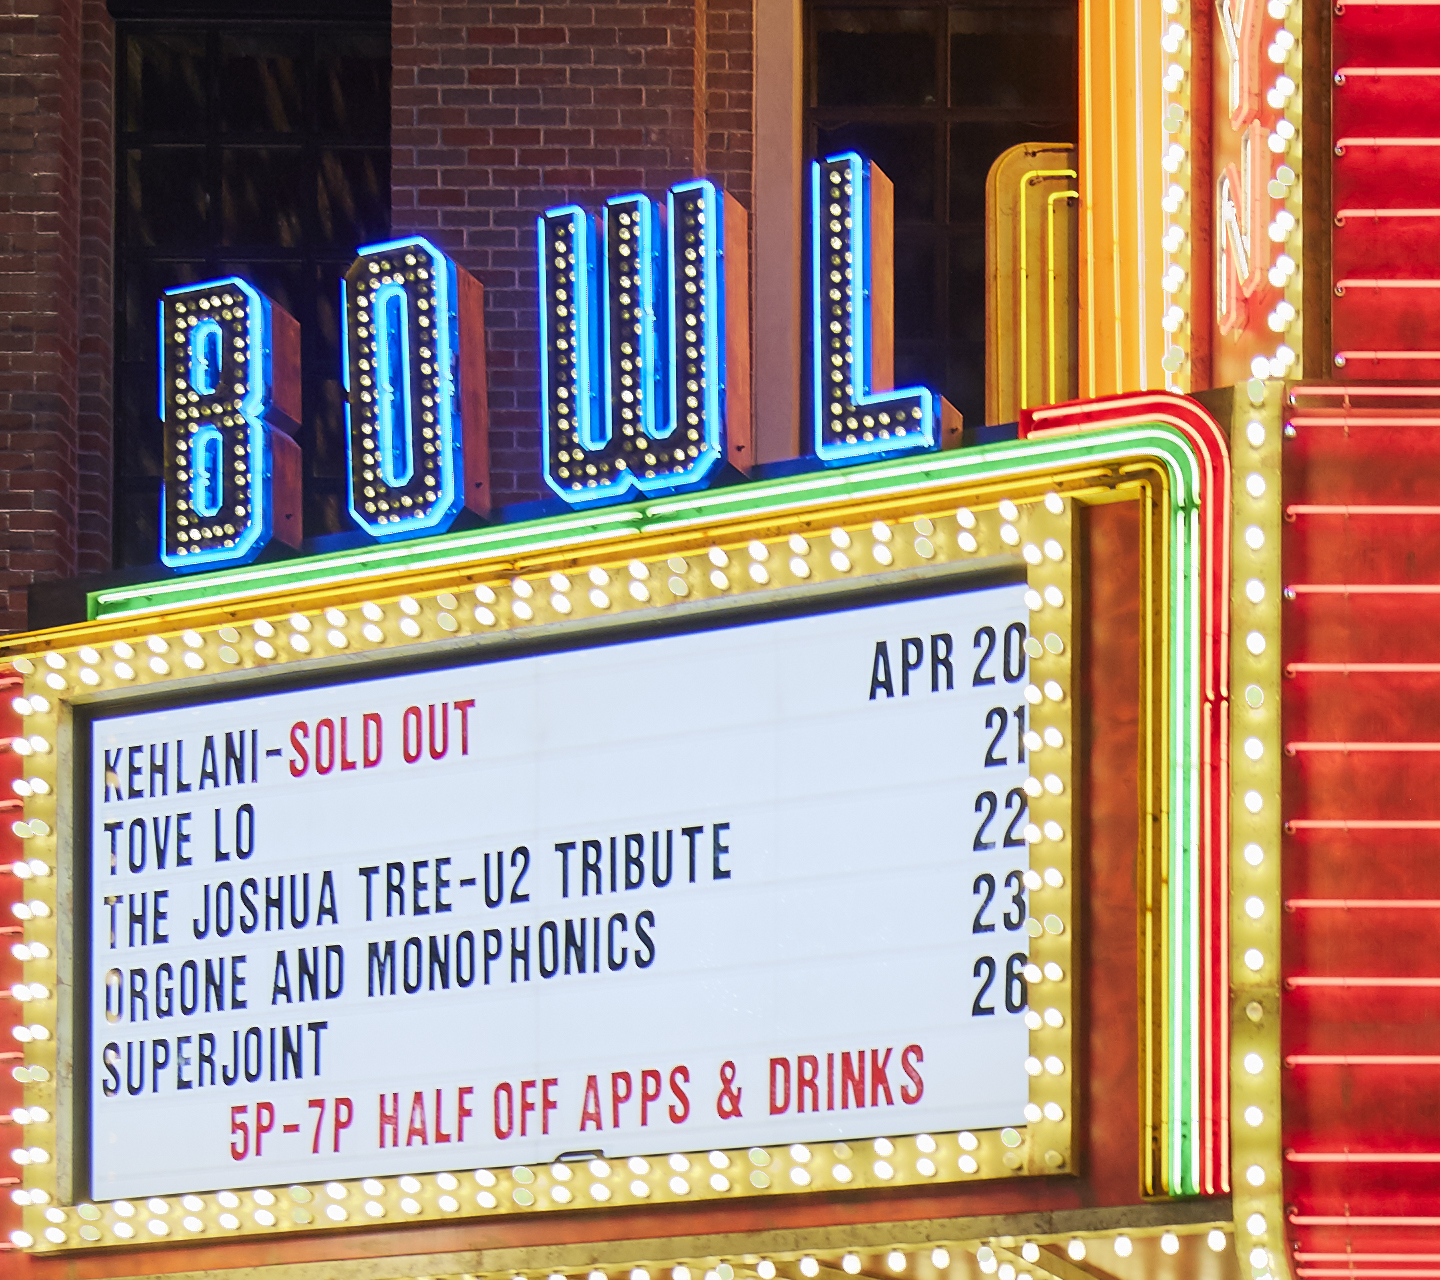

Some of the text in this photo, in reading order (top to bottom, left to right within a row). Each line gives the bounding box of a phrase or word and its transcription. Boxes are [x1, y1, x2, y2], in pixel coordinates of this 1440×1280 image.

[160, 150, 936, 568] BOWL
[870, 621, 1027, 701] APR 20
[403, 698, 476, 762] OUT
[984, 705, 1028, 769] 21
[104, 803, 256, 876] TOVE LO
[973, 787, 1028, 852] 22
[103, 888, 170, 949] THE
[193, 870, 339, 940] JOSHUA
[555, 821, 733, 899] TRIBUTE
[972, 872, 1027, 935] 23
[104, 910, 658, 1025] ORGONE AND MONOPHONICS
[972, 952, 1028, 1017] 26
[102, 1020, 329, 1097] SUPERJOINT
[379, 1086, 475, 1148] HALF
[493, 1076, 559, 1140] OFF
[580, 1062, 691, 1132] APPS
[717, 1059, 743, 1119] &
[769, 1043, 926, 1115] DRINKS
